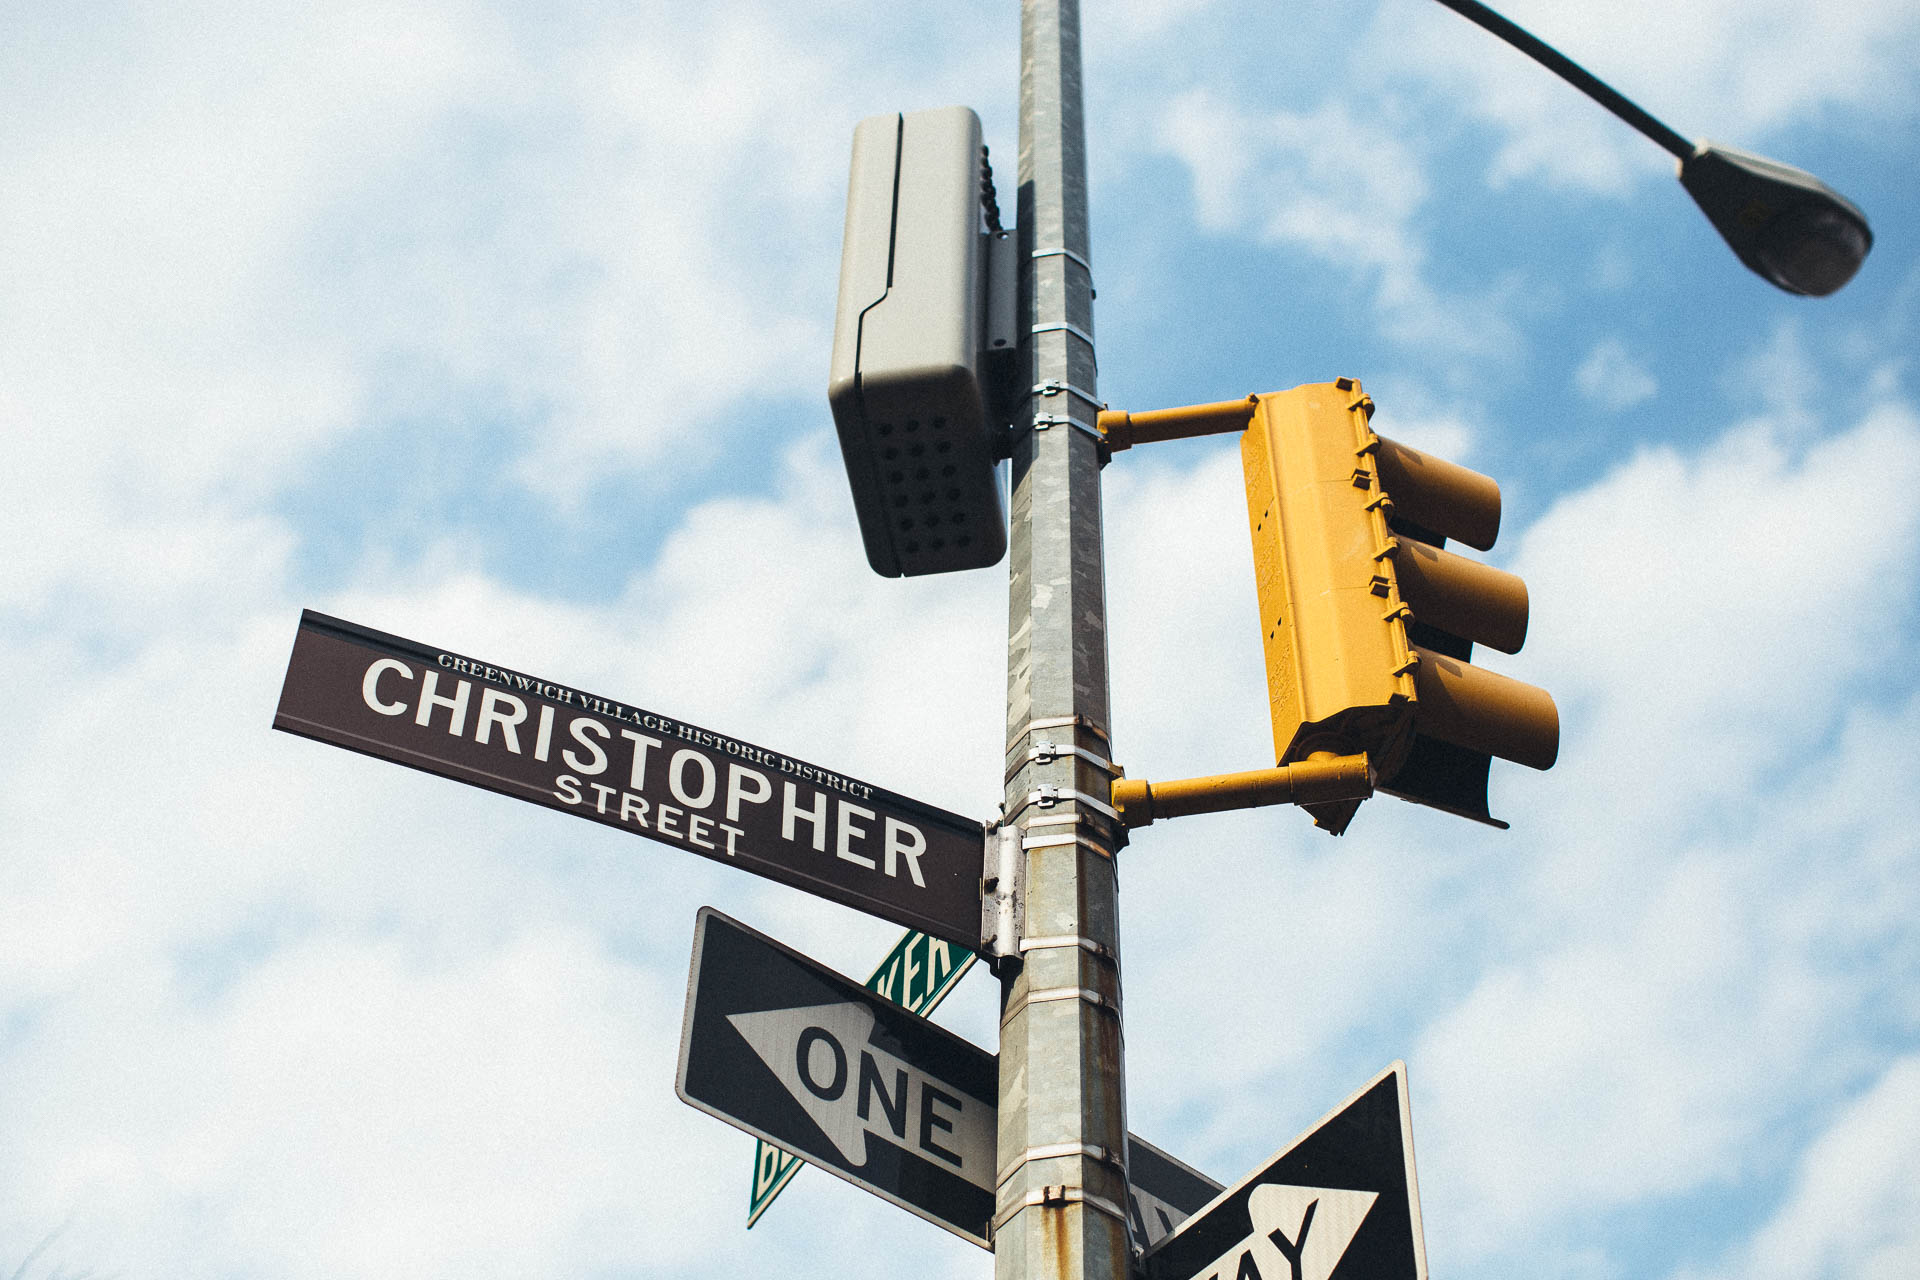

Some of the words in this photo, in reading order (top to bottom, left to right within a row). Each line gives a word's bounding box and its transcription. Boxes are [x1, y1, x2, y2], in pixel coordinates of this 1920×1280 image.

[362, 658, 927, 889] CHRISTOPHER
[437, 654, 574, 705] GREENWICH
[579, 694, 672, 735] VILLAGE
[677, 724, 776, 768] HISTORIC
[780, 757, 873, 800] DISTRICT
[553, 774, 745, 856] STREET
[796, 1026, 963, 1169] ONE
